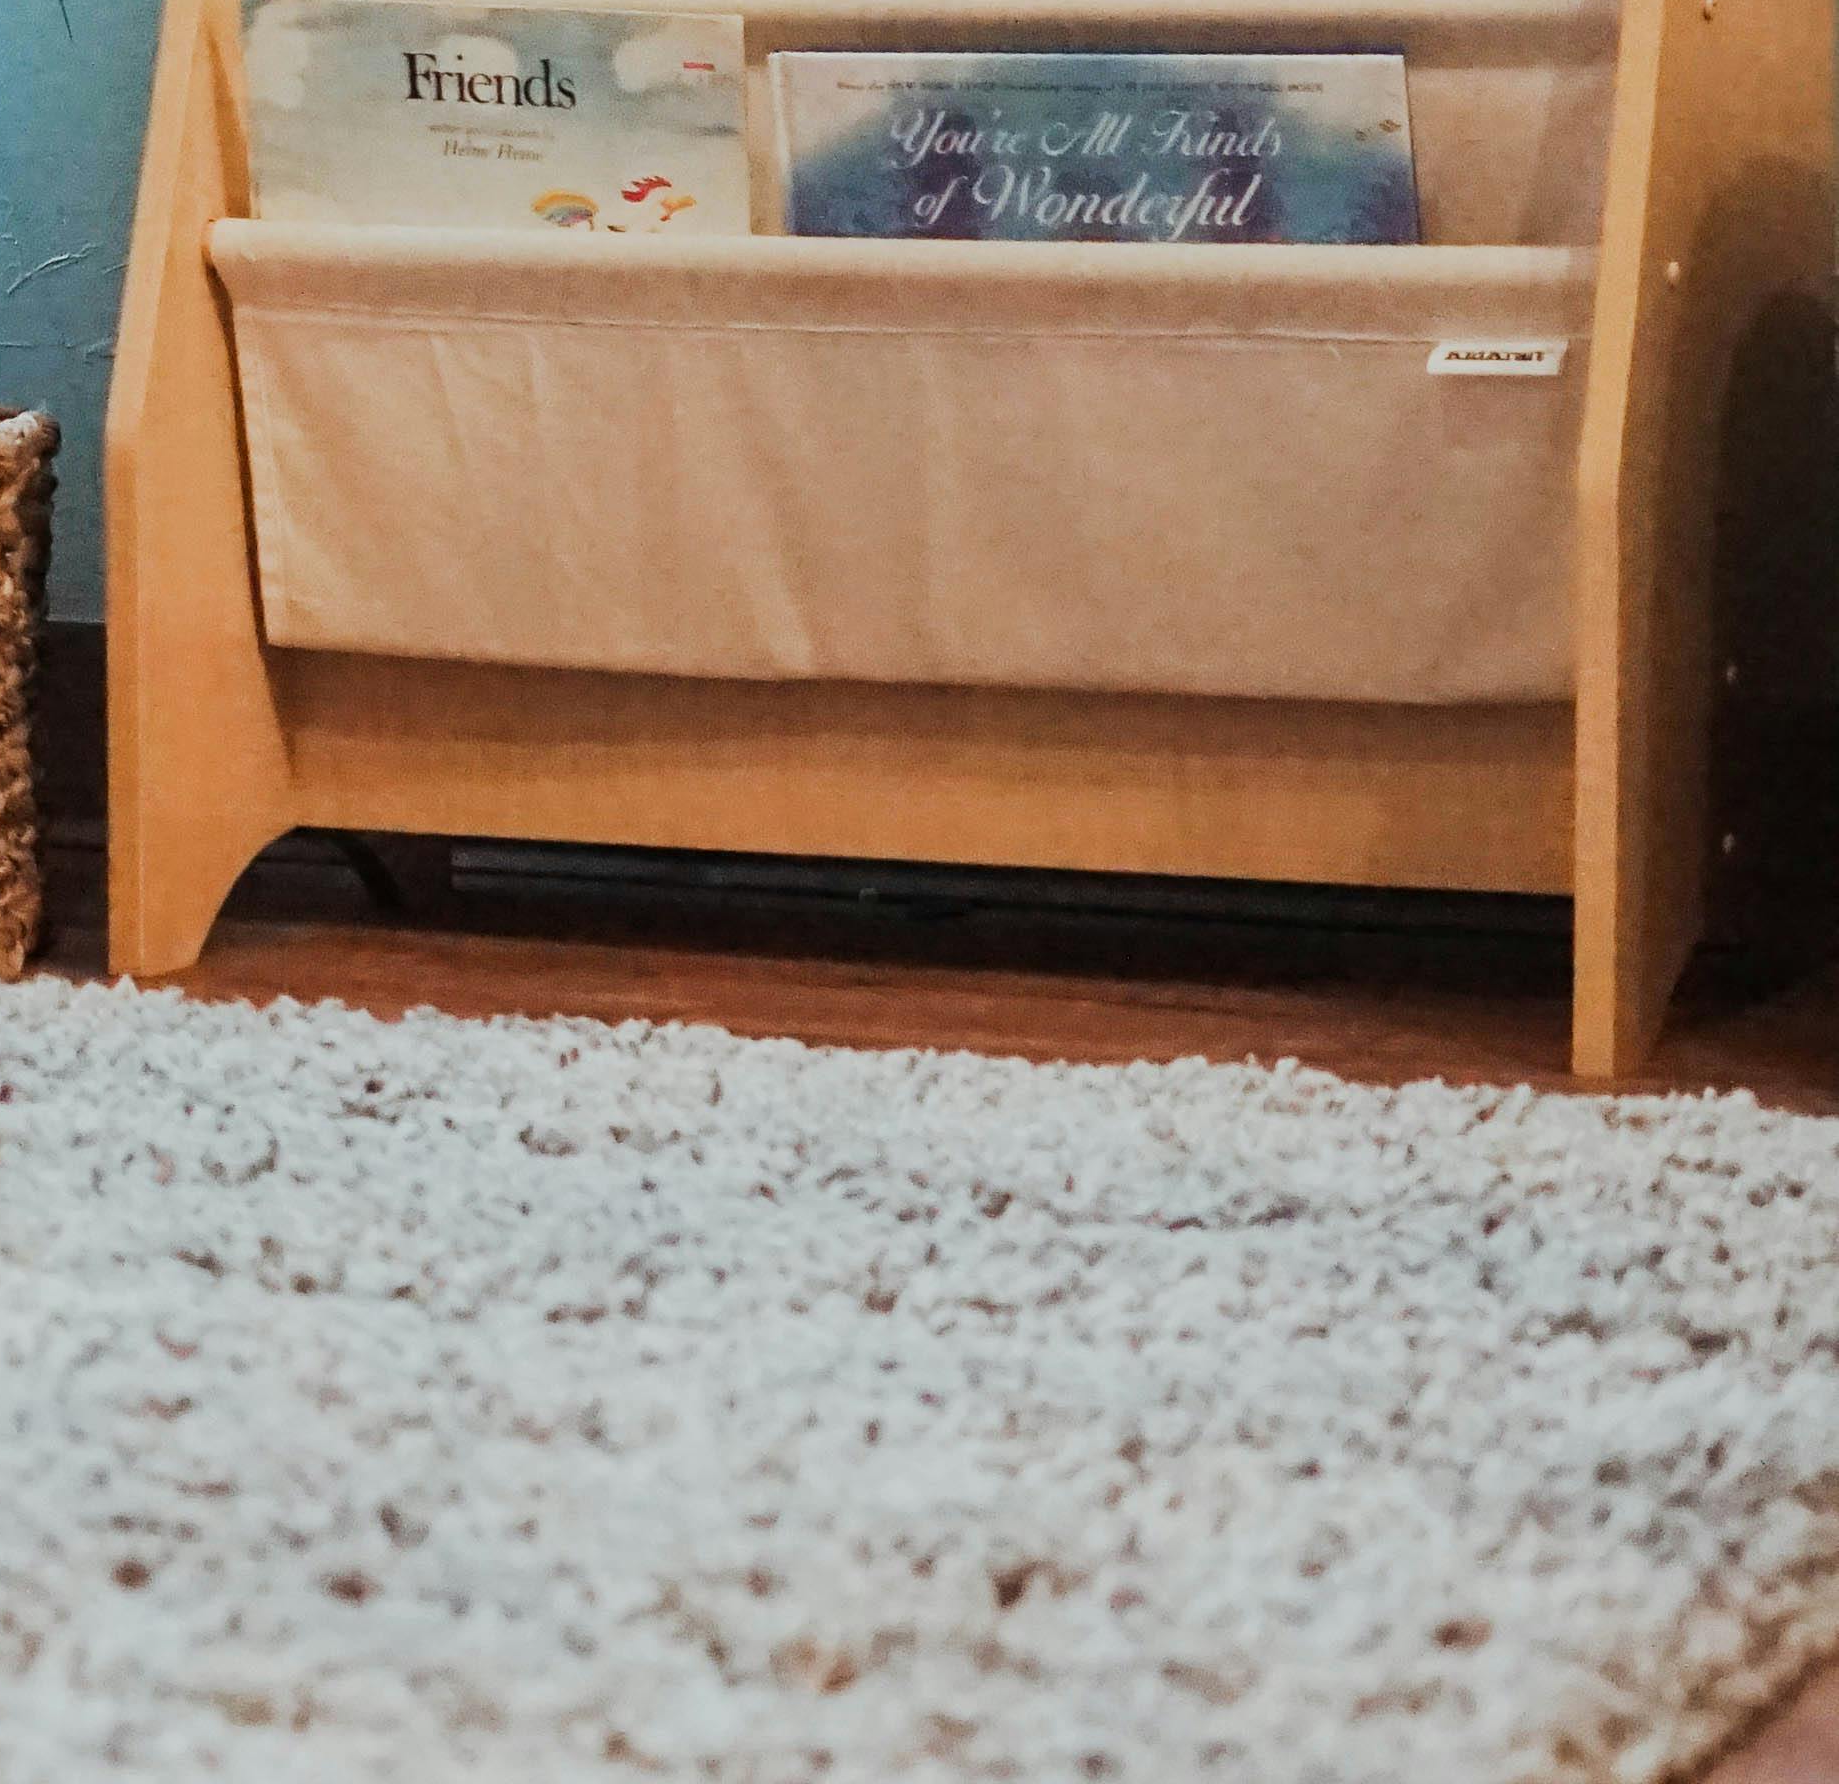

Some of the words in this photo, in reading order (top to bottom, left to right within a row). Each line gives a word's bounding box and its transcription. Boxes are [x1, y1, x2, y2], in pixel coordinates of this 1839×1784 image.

[402, 51, 578, 110] Friends
[890, 110, 1020, 171] You're
[1039, 110, 1133, 157] All
[1149, 108, 1282, 159] Kinds
[913, 173, 970, 226] of
[971, 163, 1263, 243] Wonderful
